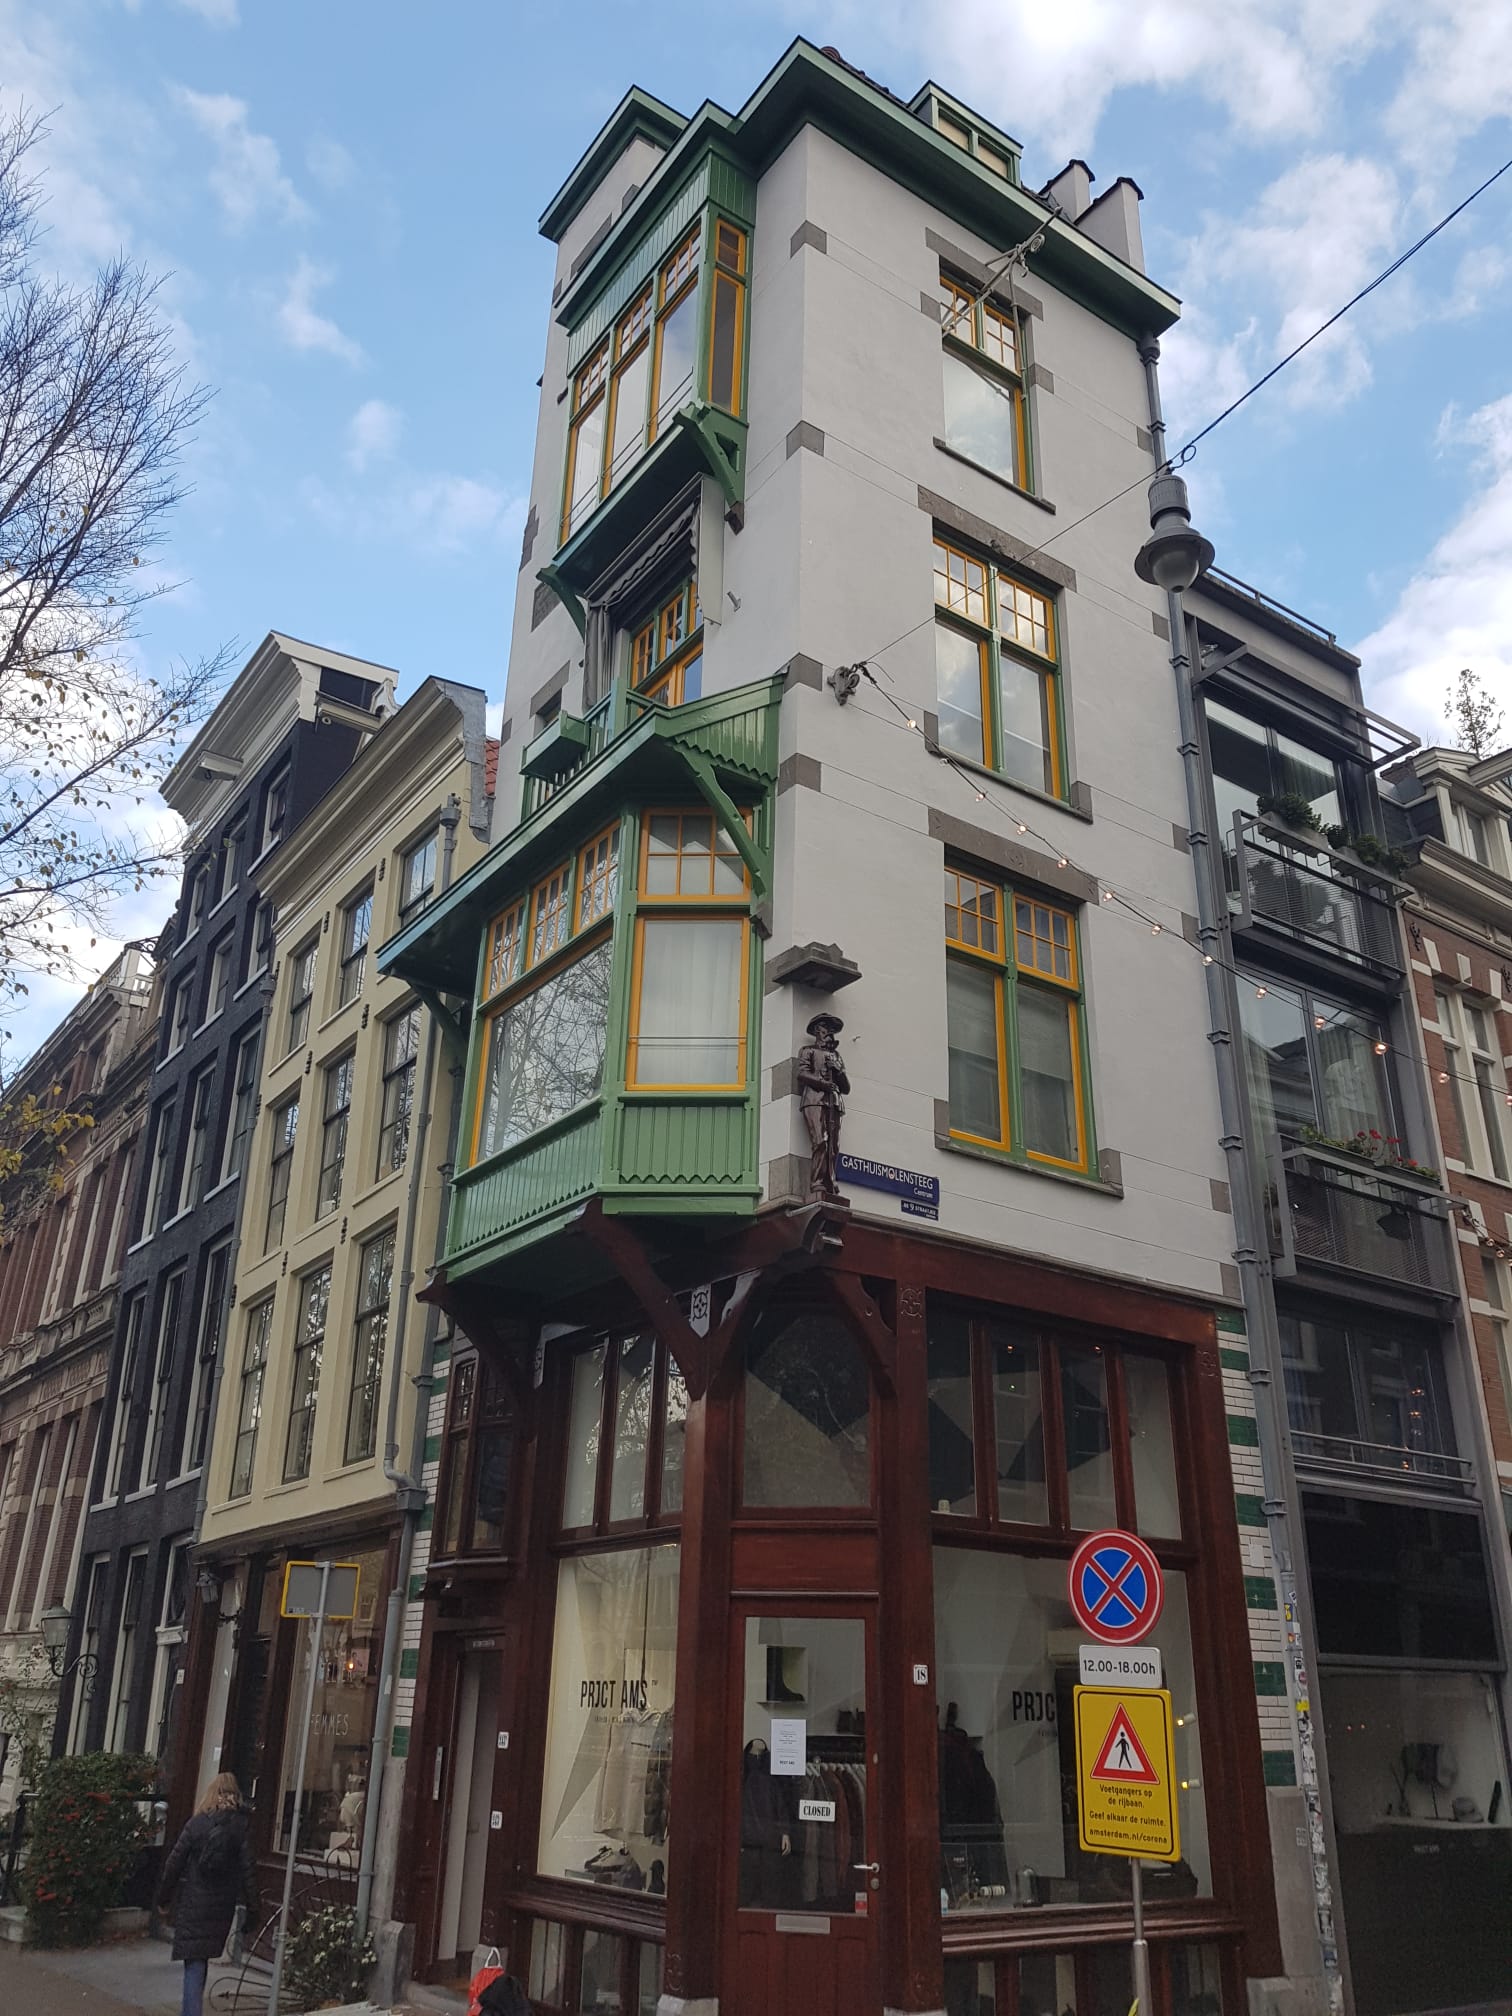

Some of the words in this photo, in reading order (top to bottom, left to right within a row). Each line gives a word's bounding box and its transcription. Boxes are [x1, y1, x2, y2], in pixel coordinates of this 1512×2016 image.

[841, 1155, 934, 1190] GASTHUISMOLENSTEEG
[913, 1187, 934, 1199] Centrum
[917, 1668, 926, 1681] 18
[1083, 1659, 1156, 1675] 12.00-18.00h
[580, 1680, 617, 1708] PRJCT
[620, 1680, 648, 1710] AMS
[1100, 1784, 1142, 1798] Voetgangers
[1143, 1789, 1153, 1799] op
[1107, 1797, 1117, 1805] de
[1118, 1798, 1145, 1809] rijbaan.
[803, 1805, 831, 1817] CLOSED
[1089, 1810, 1105, 1820] Geef
[1106, 1812, 1128, 1823] elkaar
[1129, 1815, 1138, 1824] de
[1140, 1817, 1166, 1827] ruimte.
[1089, 1828, 1168, 1844] amsterdam.nl/corona
